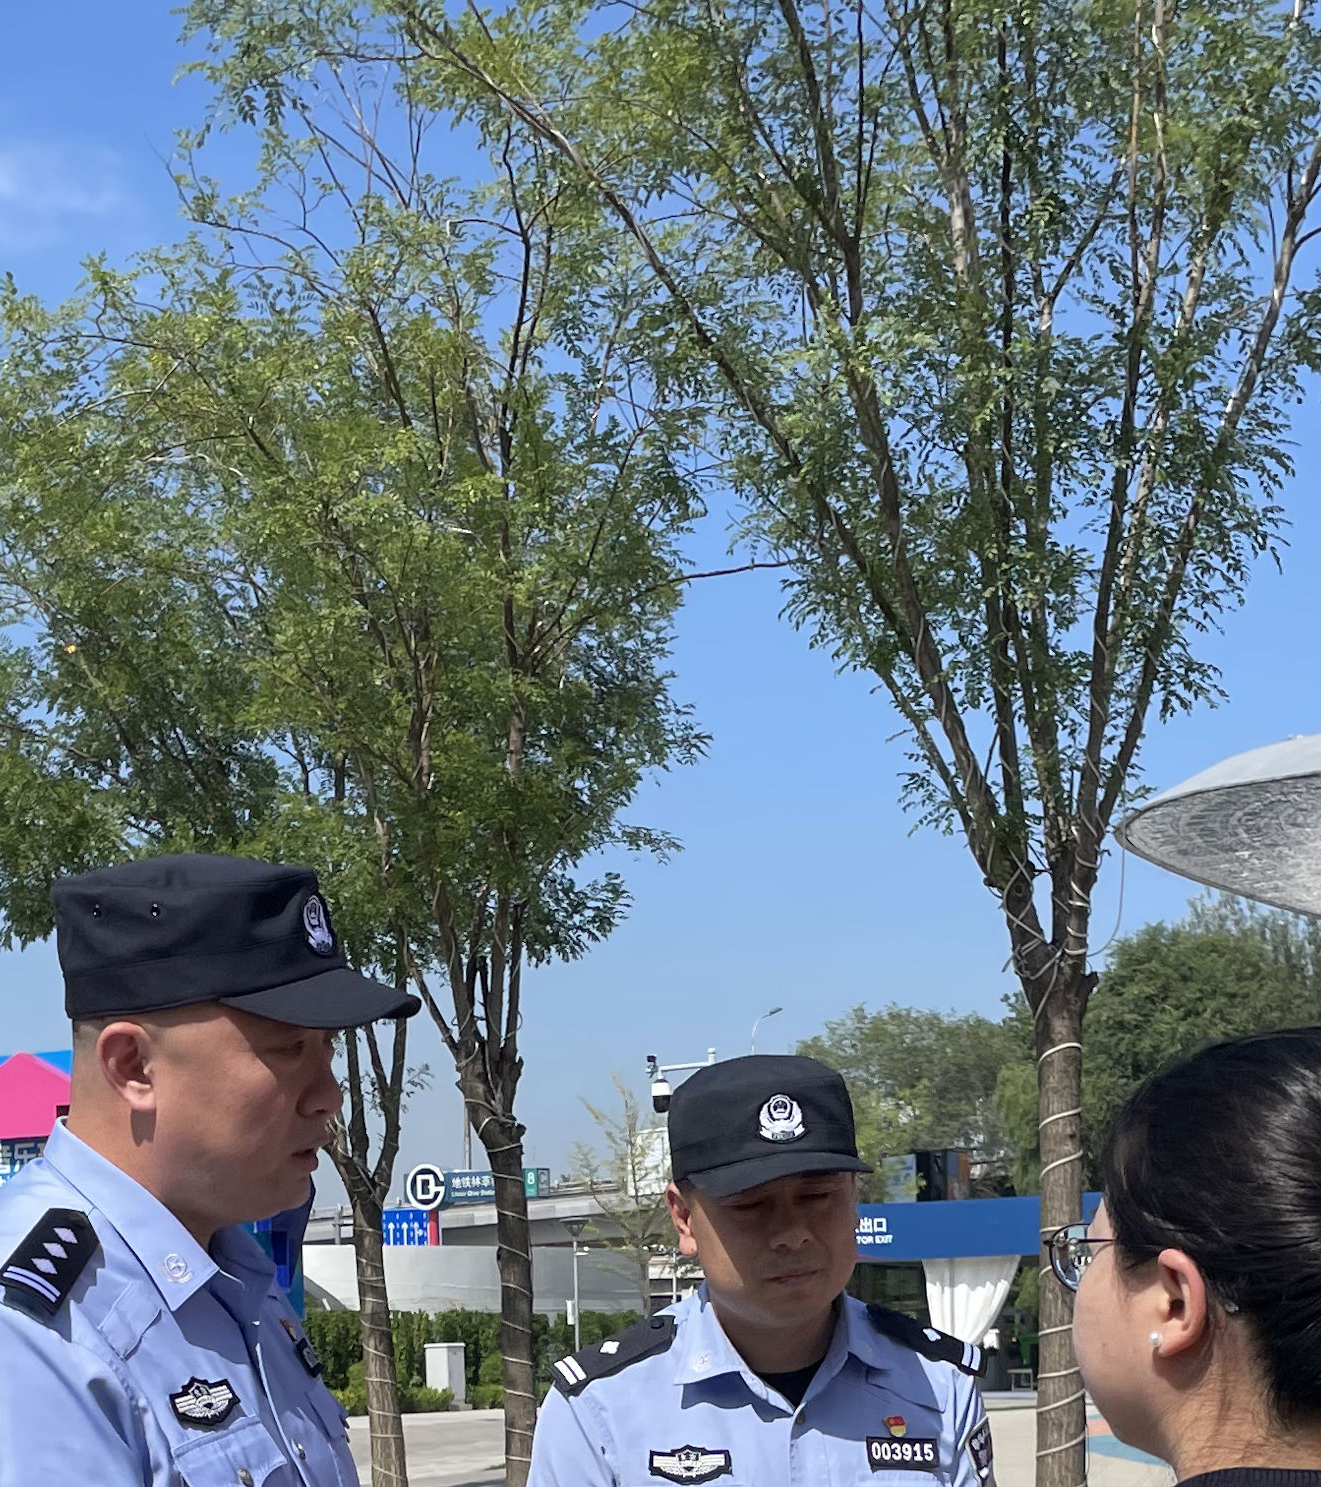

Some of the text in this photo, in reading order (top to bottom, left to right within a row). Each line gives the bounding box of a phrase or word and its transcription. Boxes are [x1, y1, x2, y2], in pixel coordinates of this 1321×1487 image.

[527, 1172, 535, 1185] 8
[855, 1216, 887, 1233] 出口
[875, 1234, 893, 1244] EXIT
[871, 1441, 935, 1462] 003915
